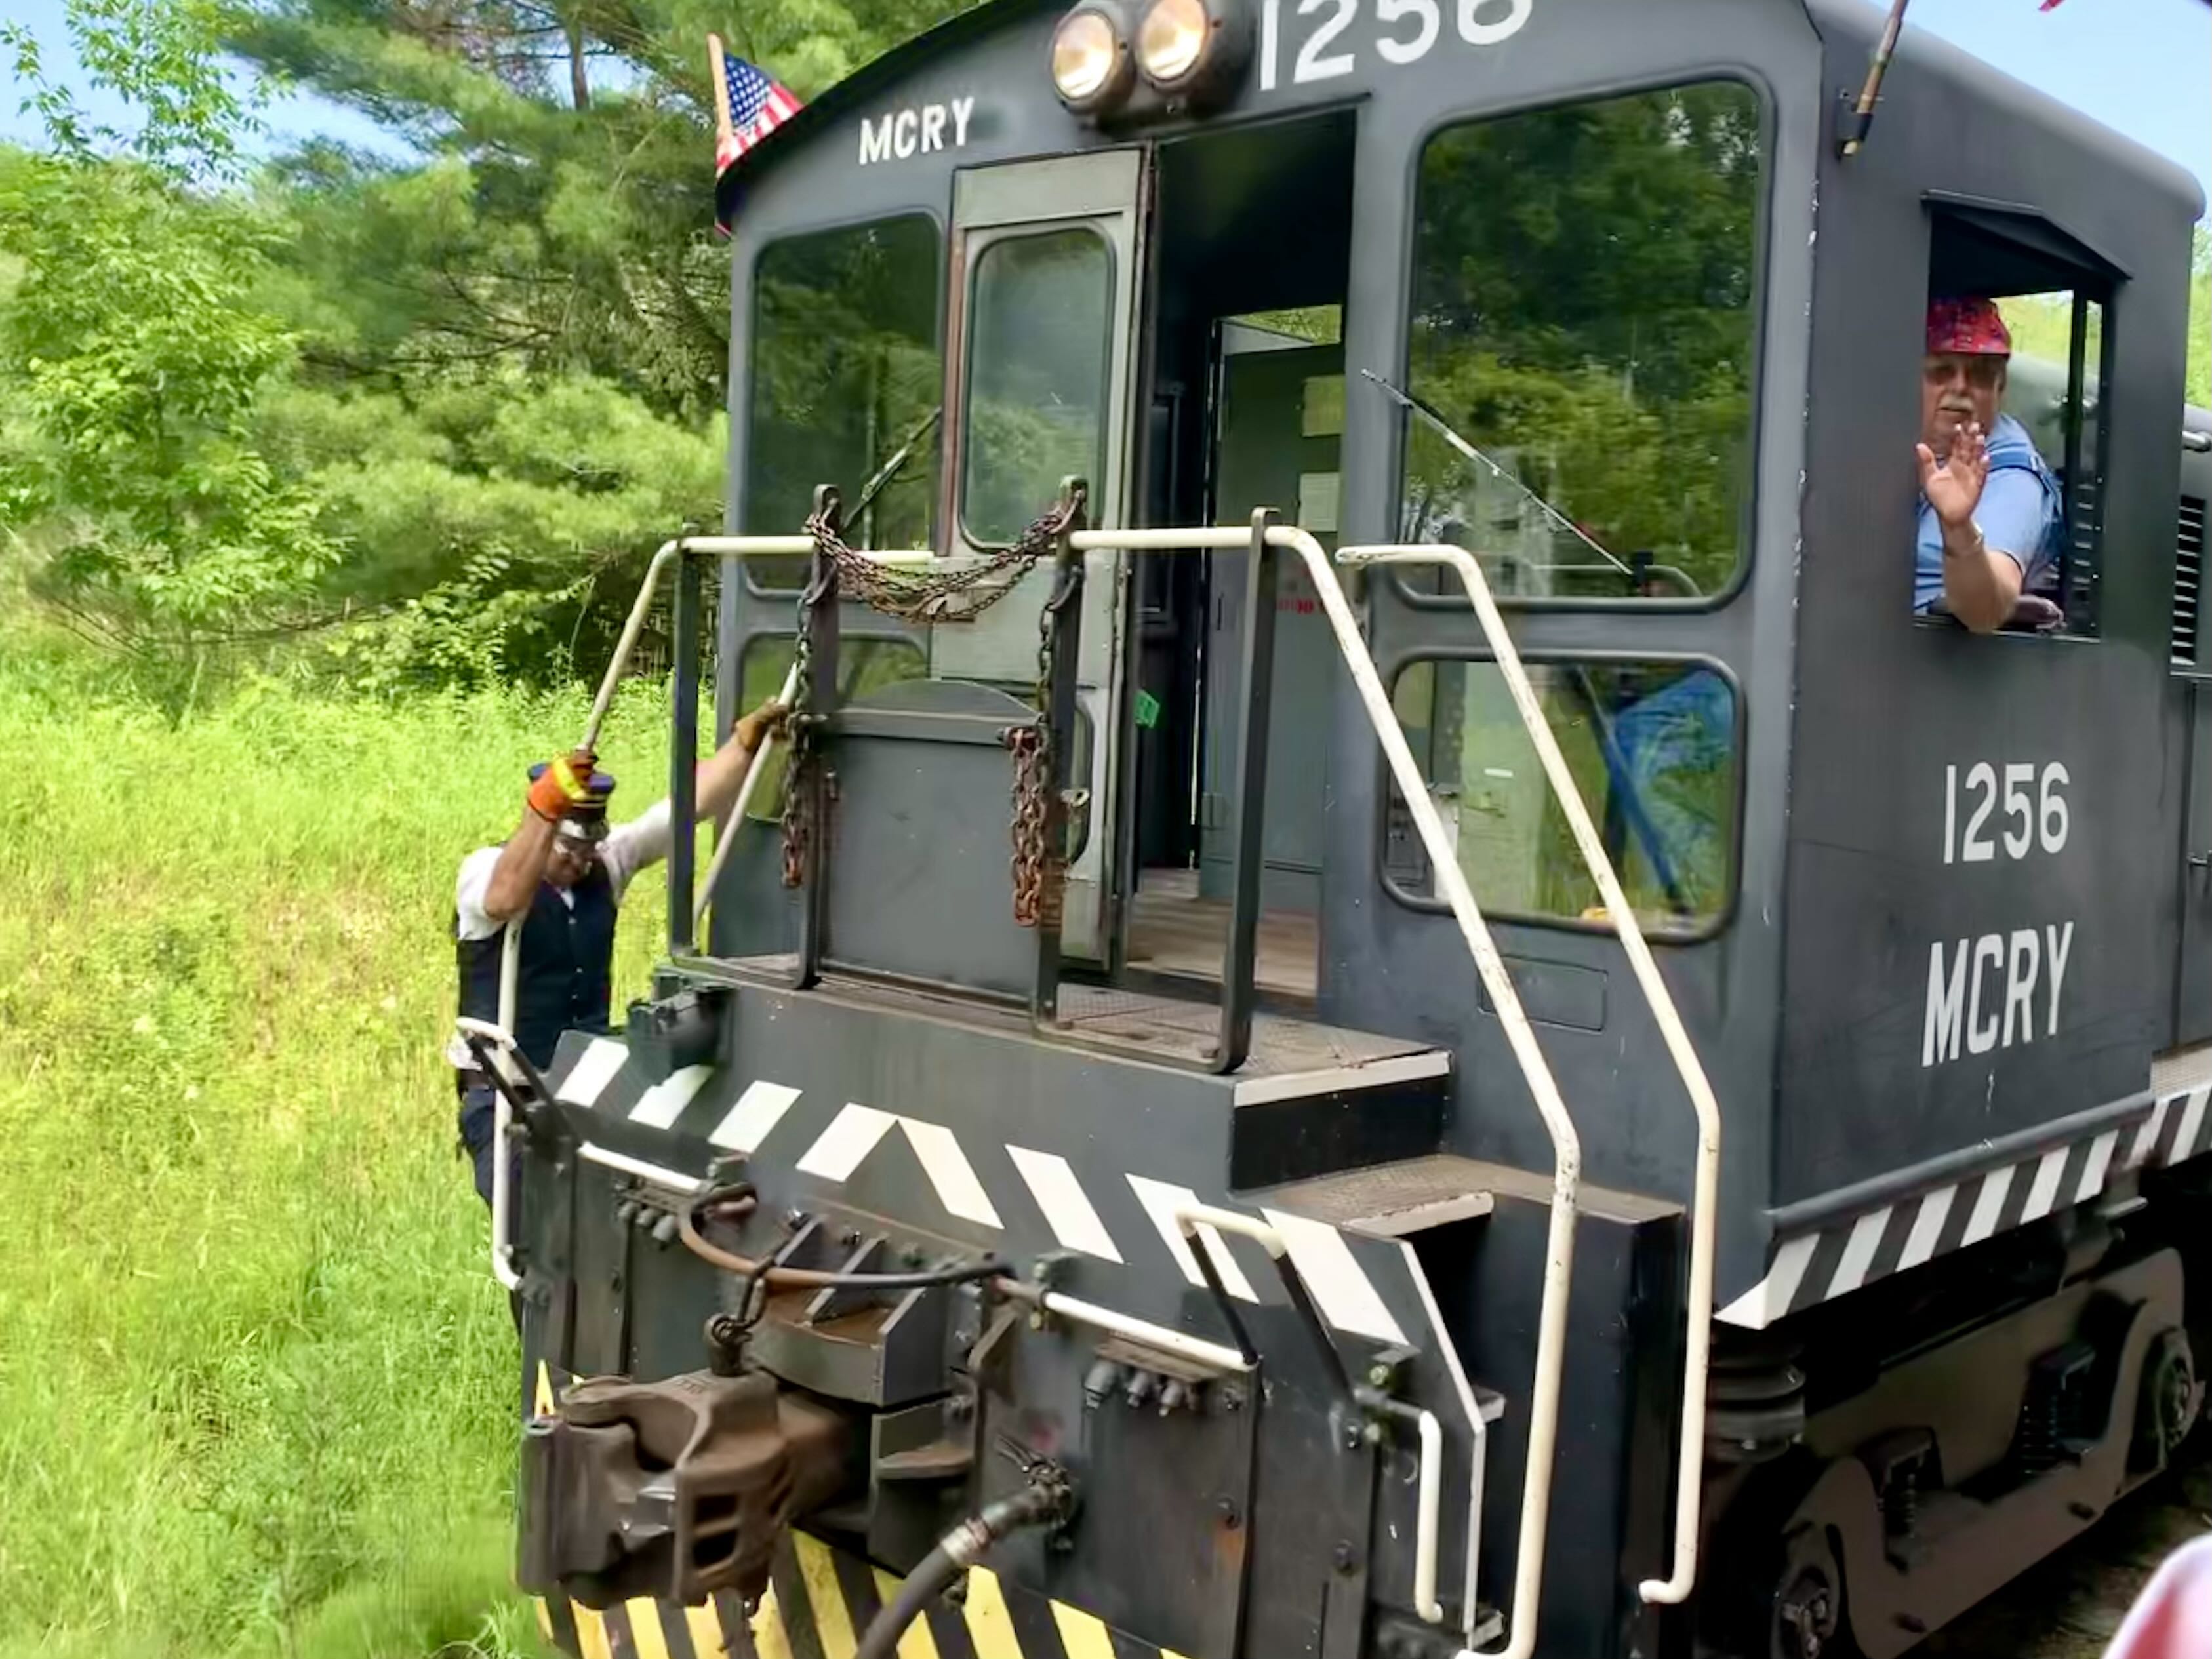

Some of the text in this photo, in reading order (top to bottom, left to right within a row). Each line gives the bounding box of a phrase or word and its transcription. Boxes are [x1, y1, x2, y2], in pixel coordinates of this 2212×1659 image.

[858, 96, 975, 165] MCRY
[1943, 761, 2070, 864] 1256
[1921, 921, 2074, 1068] MCRY
